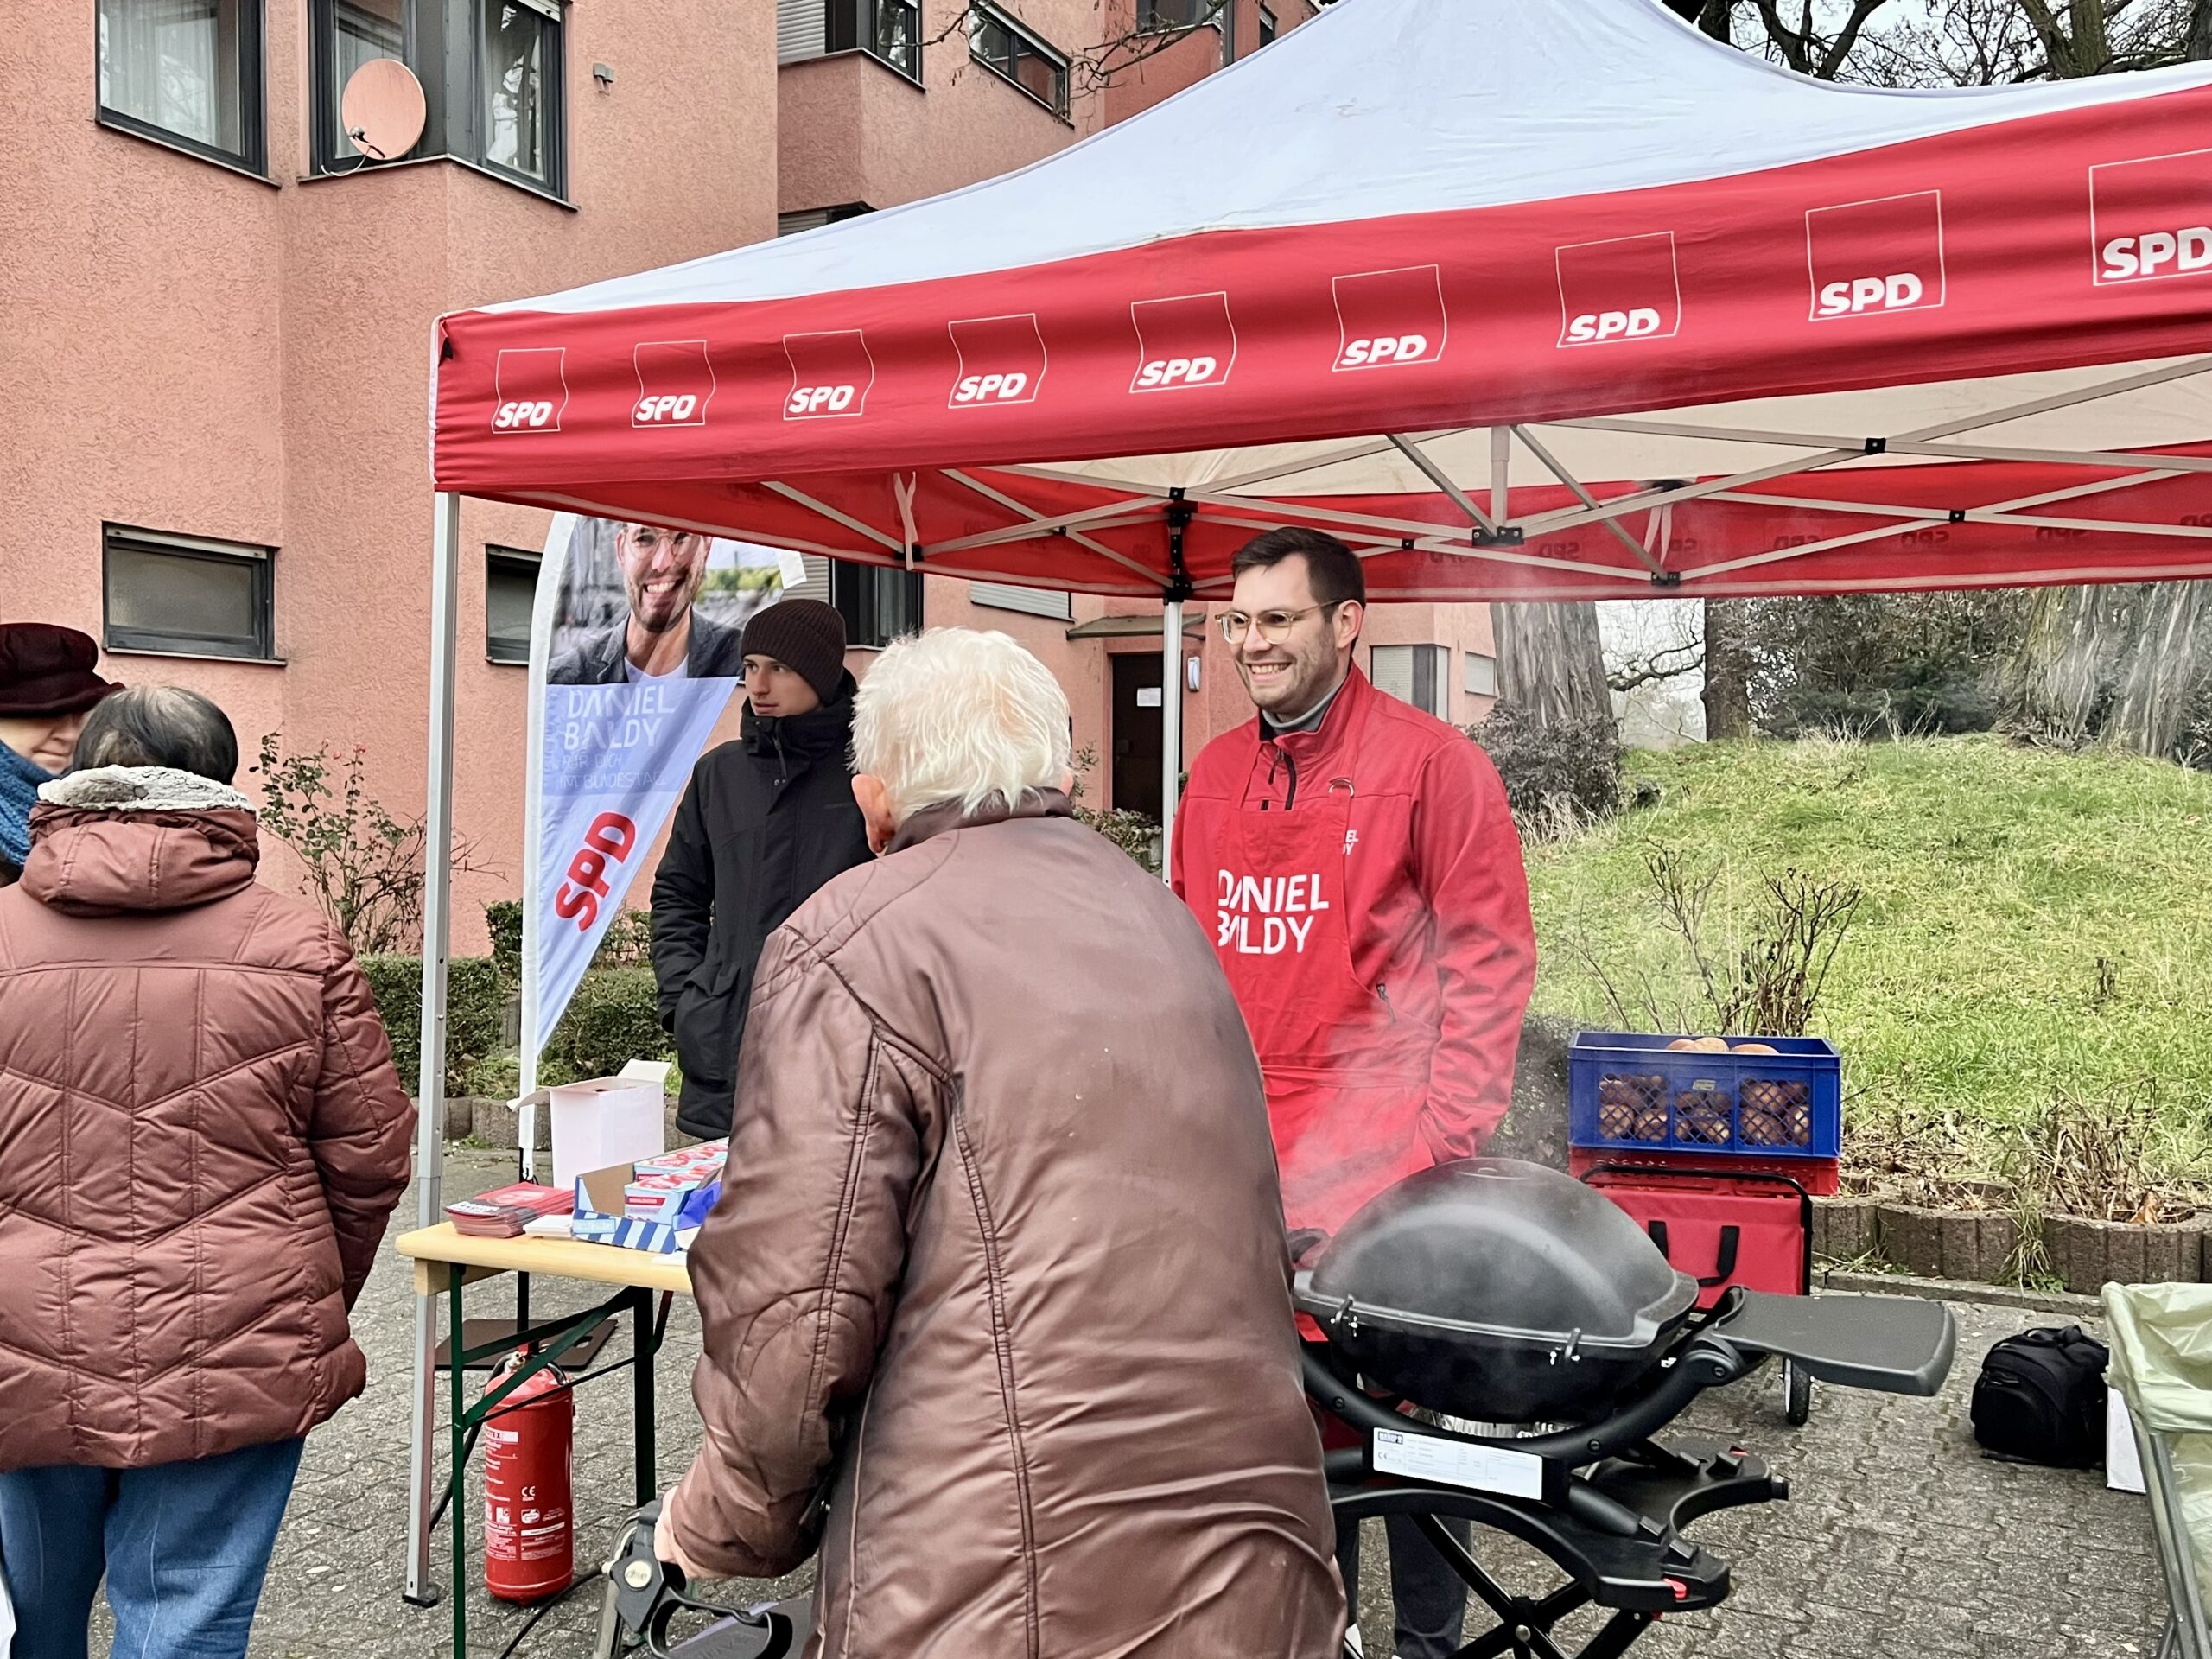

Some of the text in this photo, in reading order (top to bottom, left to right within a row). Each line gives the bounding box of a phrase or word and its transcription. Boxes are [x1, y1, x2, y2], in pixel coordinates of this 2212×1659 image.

[2101, 226, 2212, 278] SPD
[1818, 273, 1923, 315] SPD
[1566, 308, 1660, 343] SPD
[1340, 334, 1427, 366] SPD
[1137, 357, 1216, 385] SPD
[788, 385, 855, 413] SPD
[955, 373, 1027, 402] SPD
[494, 401, 553, 427] SPD
[635, 394, 696, 421] SPD
[567, 685, 676, 719] DANIEL
[563, 717, 663, 750] BALDY
[555, 810, 637, 932] SPD
